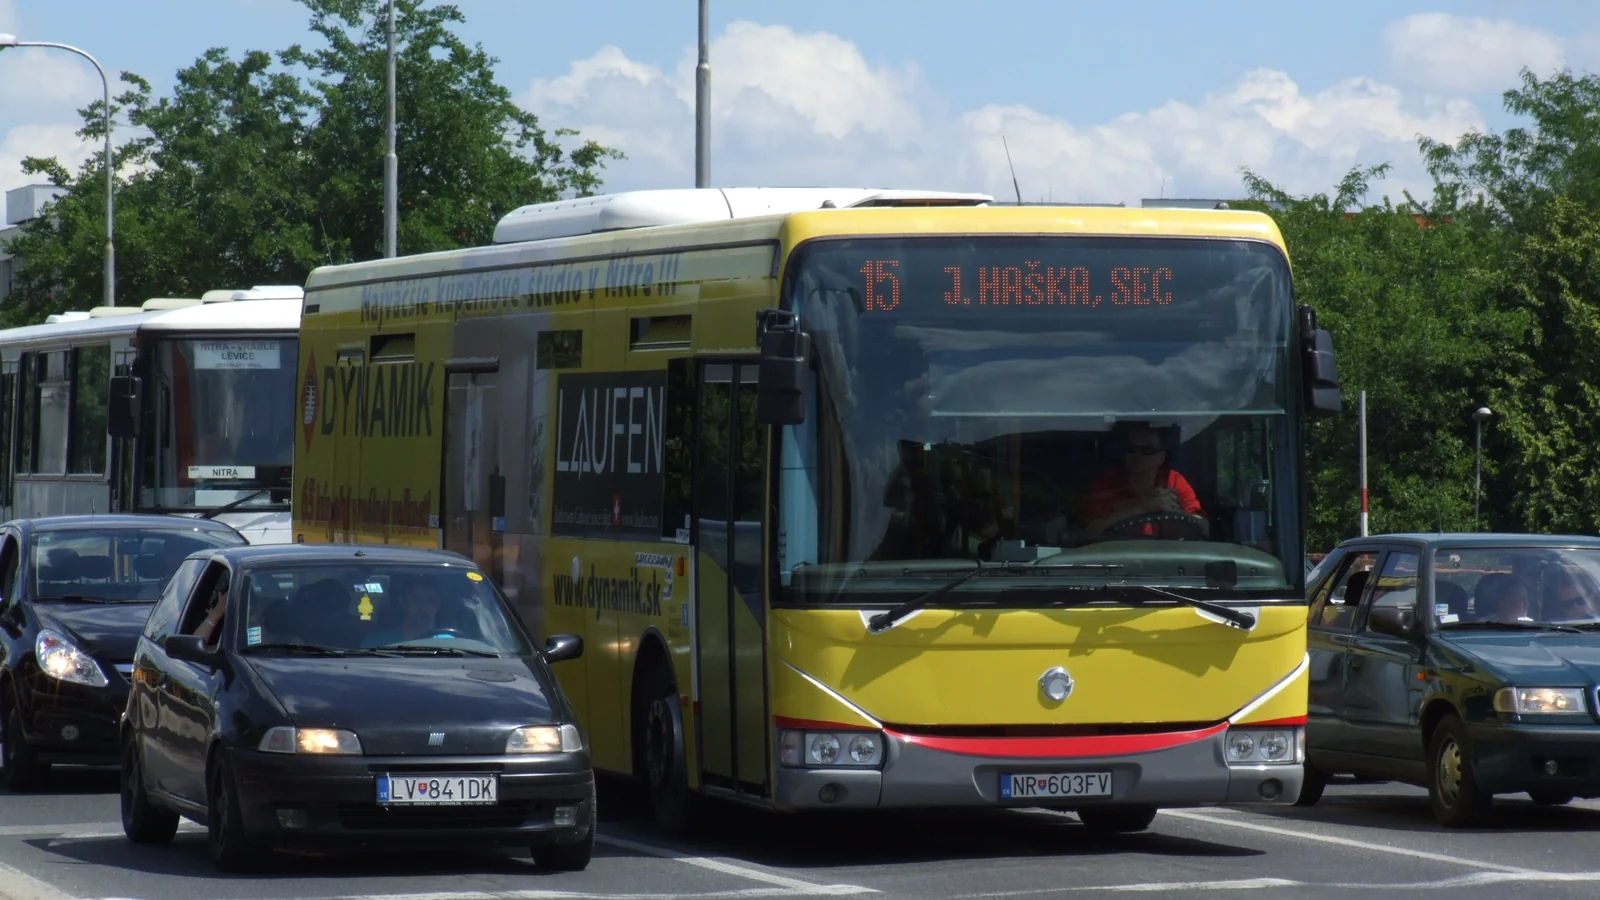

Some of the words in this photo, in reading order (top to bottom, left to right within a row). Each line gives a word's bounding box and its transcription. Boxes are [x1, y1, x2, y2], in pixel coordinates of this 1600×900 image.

[588, 267, 599, 300] v
[859, 260, 899, 311] 15
[979, 261, 1102, 308] HAŠKA,
[1111, 267, 1172, 305] SEC
[200, 343, 230, 351] NITRA
[221, 352, 255, 360] LEVICE
[321, 361, 435, 438] DYNAMIK
[556, 386, 664, 480] LAUFEN
[212, 468, 239, 476] NITRA
[553, 563, 662, 621] www.dynamik.sk
